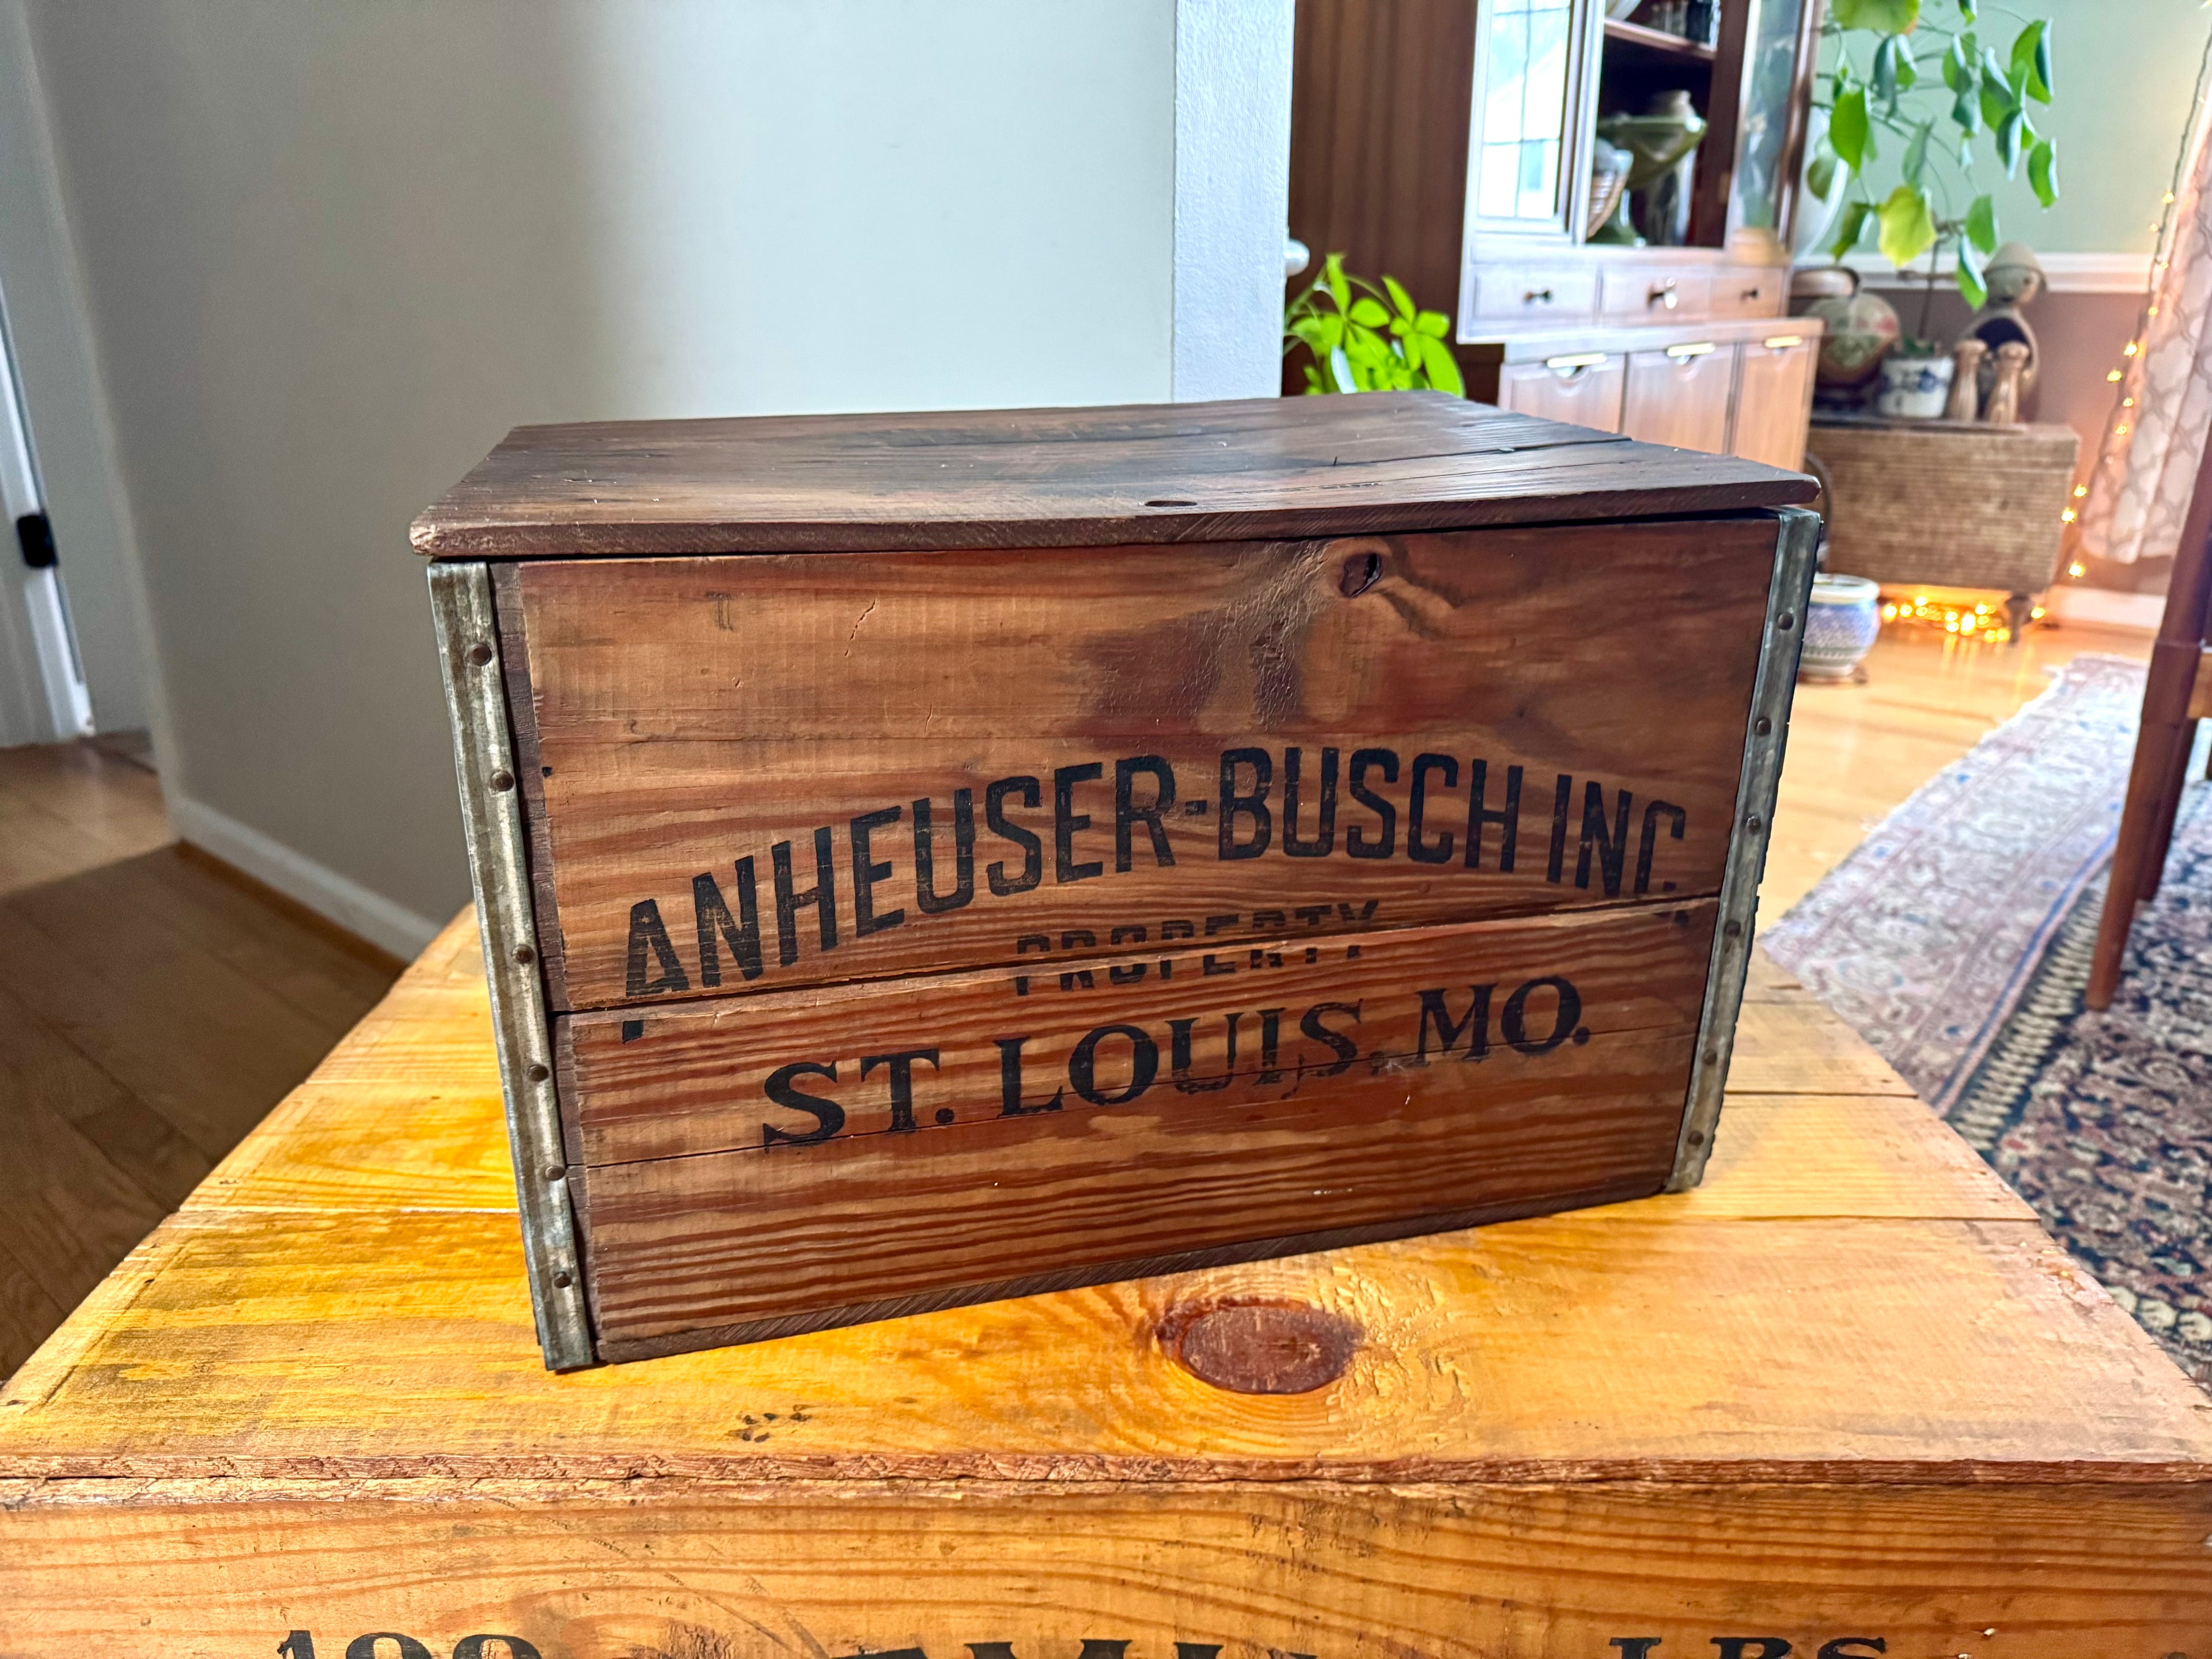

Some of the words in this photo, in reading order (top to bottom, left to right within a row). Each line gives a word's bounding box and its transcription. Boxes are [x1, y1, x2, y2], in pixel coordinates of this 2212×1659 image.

[622, 747, 1523, 1044] ANHEUSER-BUSCH
[1016, 900, 1378, 996] PROPERTY
[763, 1048, 955, 1152] ST.
[1416, 975, 1590, 1068] MO.
